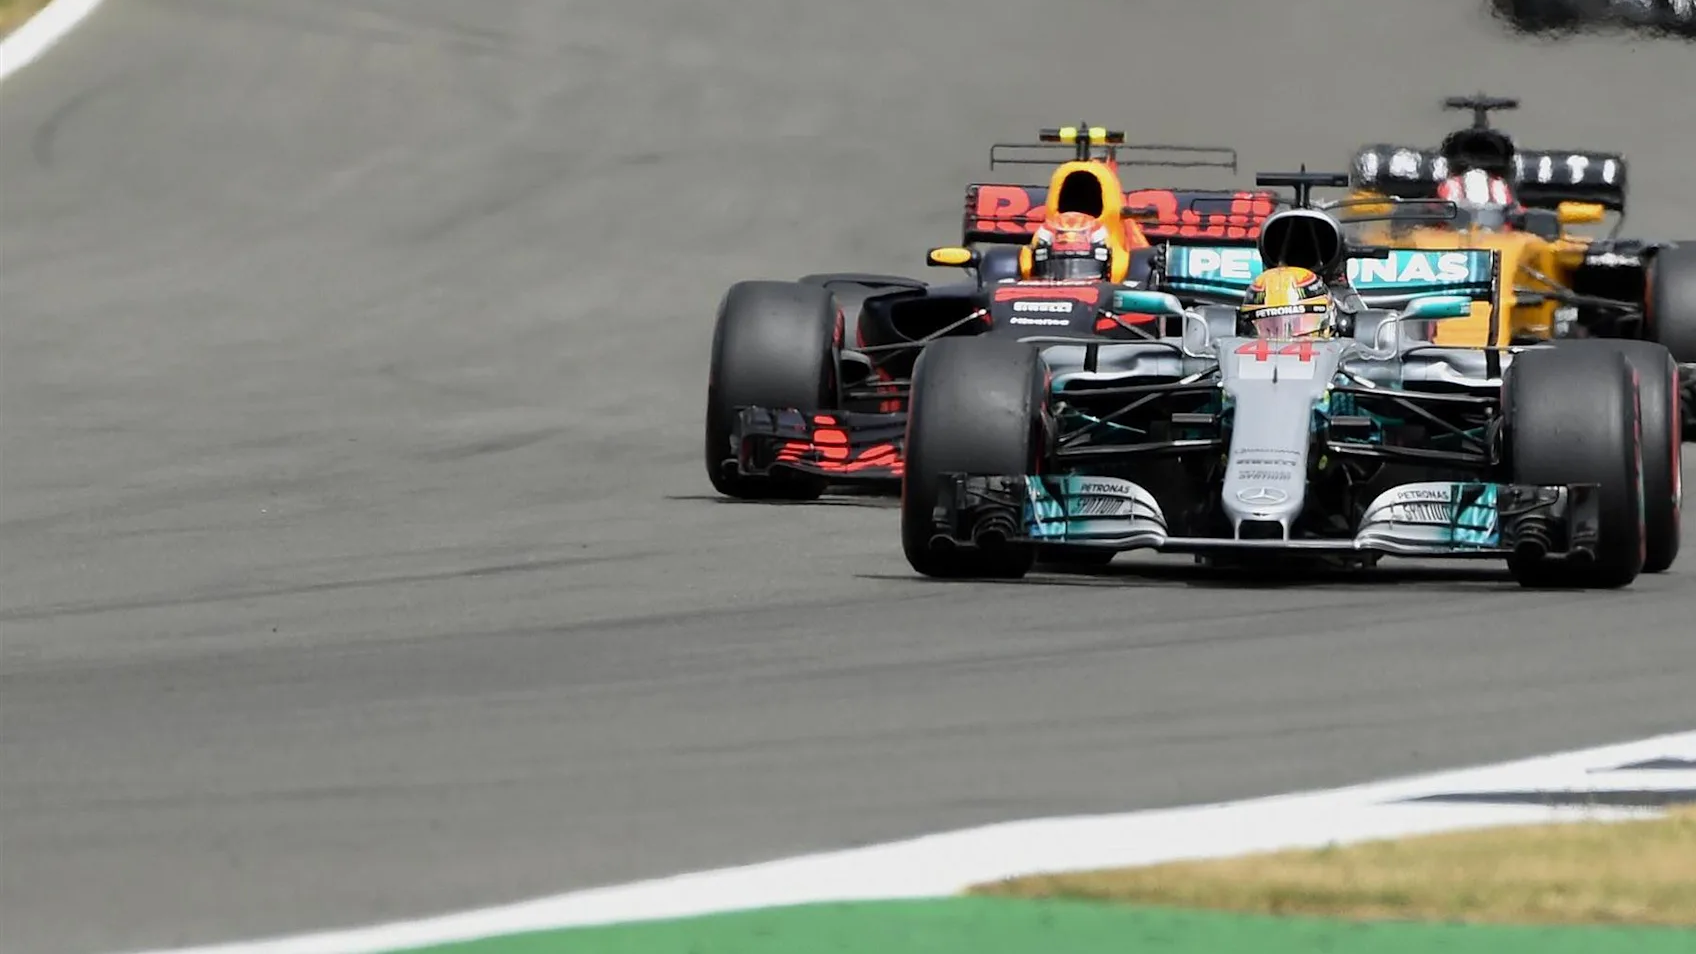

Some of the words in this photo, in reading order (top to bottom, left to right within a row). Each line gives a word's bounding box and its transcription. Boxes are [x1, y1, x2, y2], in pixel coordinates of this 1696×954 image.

[1189, 249, 1469, 282] PENAS
[1255, 305, 1306, 318] PETRONAS
[1234, 339, 1320, 362] 44
[1081, 483, 1130, 494] PETRONAS
[1397, 489, 1449, 500] PETRONAS
